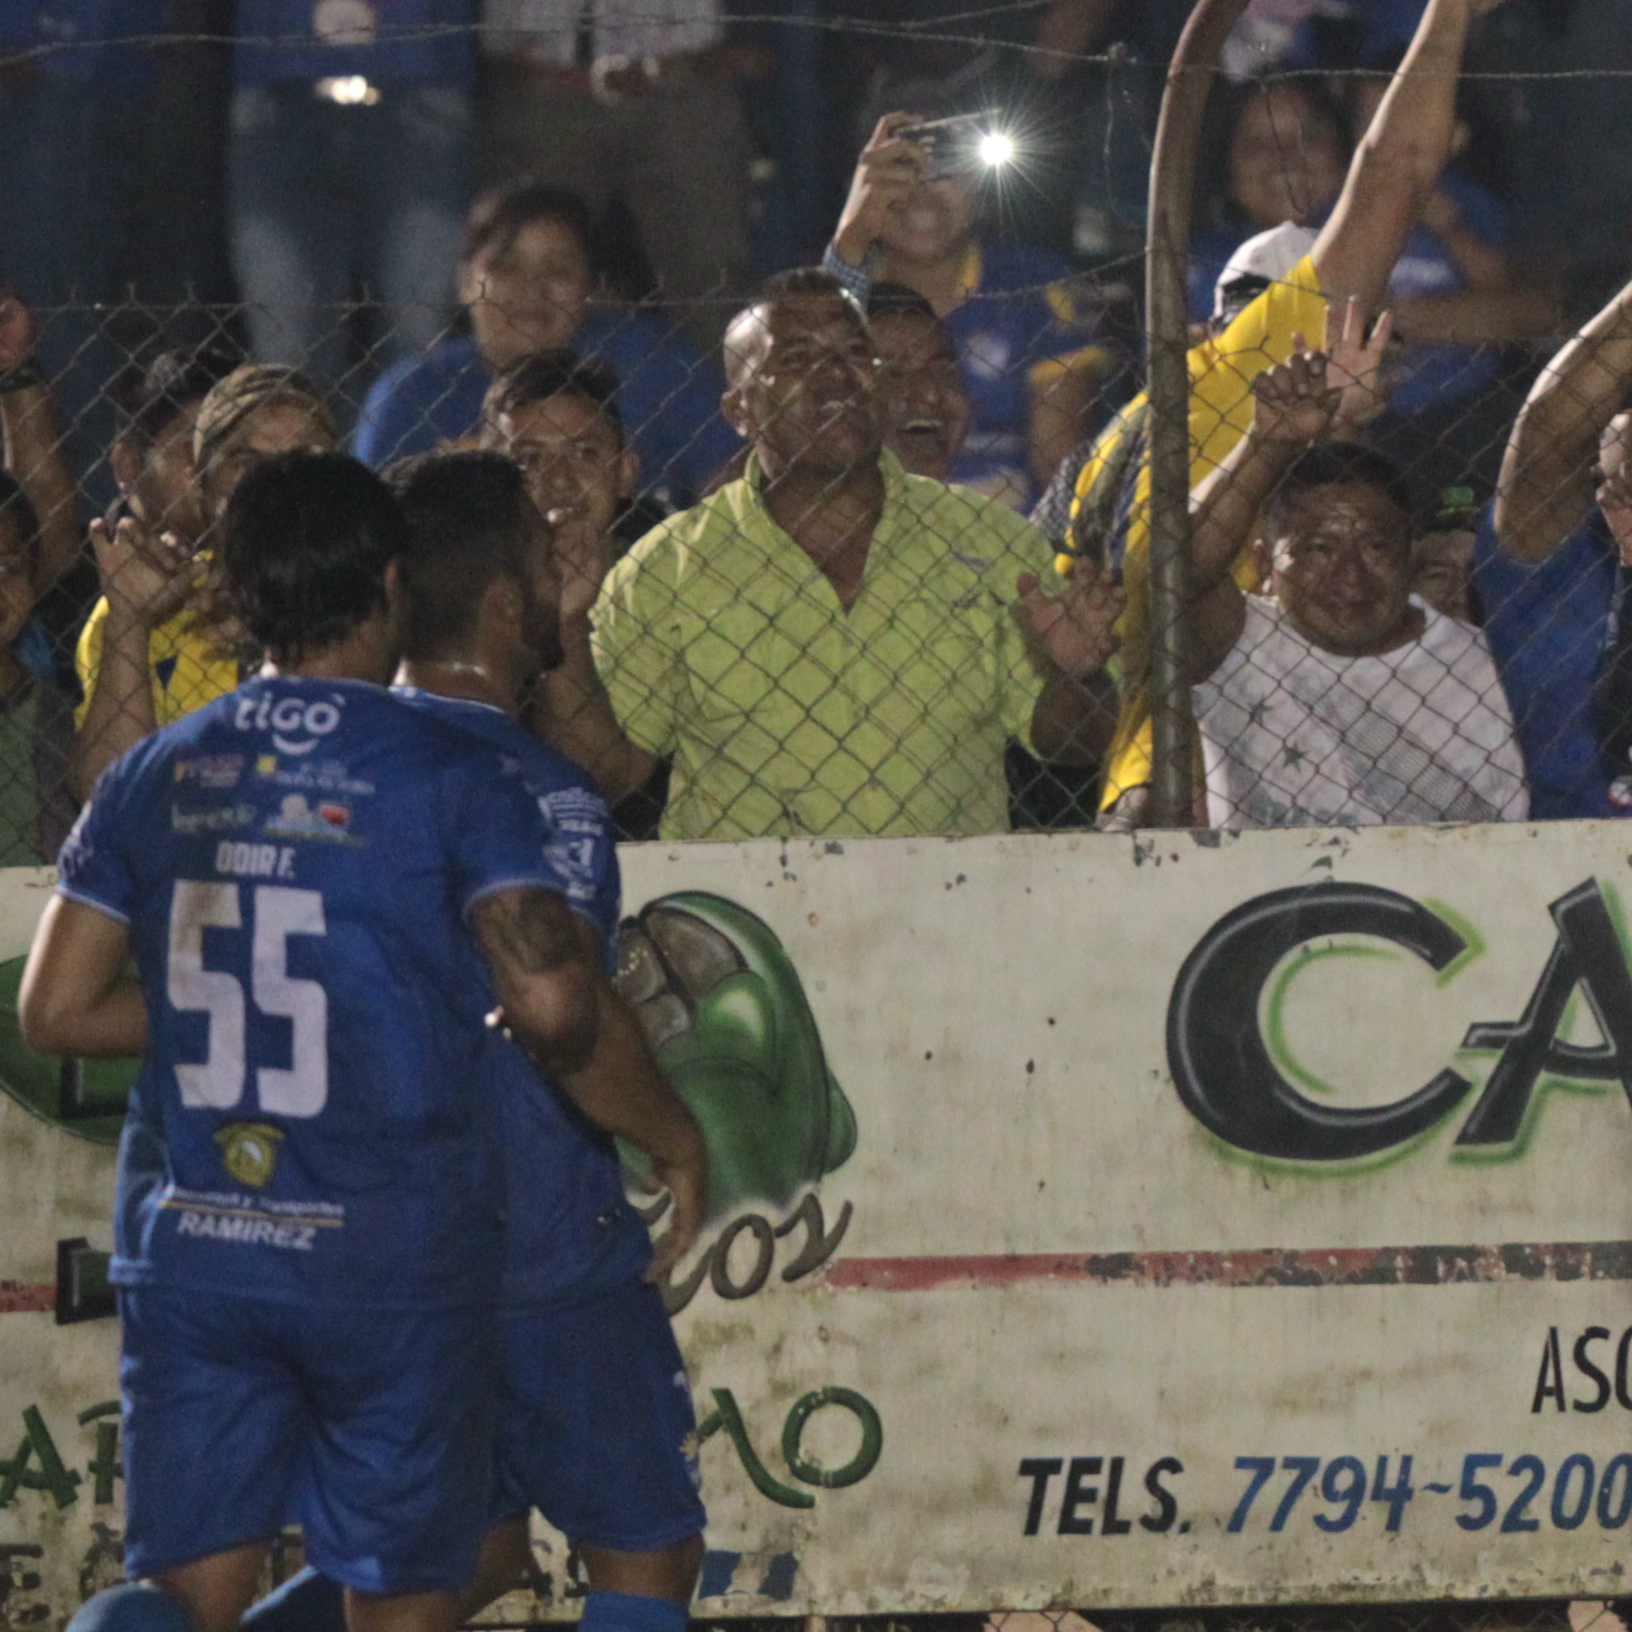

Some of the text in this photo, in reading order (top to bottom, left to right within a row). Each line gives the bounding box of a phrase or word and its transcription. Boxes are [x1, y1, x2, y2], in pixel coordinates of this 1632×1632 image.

[166, 879, 329, 1119] 55
[176, 1211, 317, 1252] RAMIREZ
[1018, 1455, 1192, 1537] TELS.
